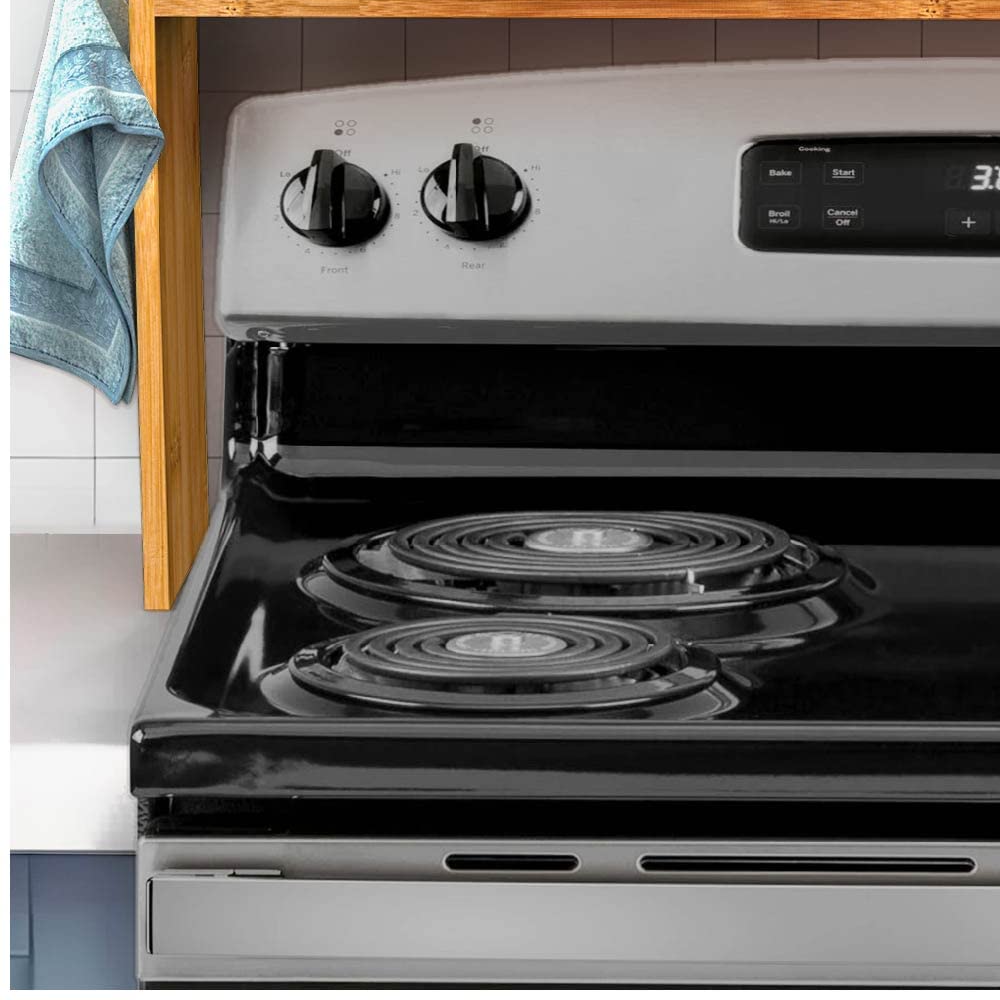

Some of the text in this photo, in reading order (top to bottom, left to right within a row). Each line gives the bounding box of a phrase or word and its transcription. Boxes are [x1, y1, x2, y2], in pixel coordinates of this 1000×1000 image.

[769, 168, 793, 177] Bake
[832, 168, 856, 176] Start
[768, 209, 791, 218] Broil
[826, 208, 858, 216] Cancel
[835, 218, 851, 226] Off
[321, 266, 349, 274] Front
[462, 262, 486, 270] Rear
